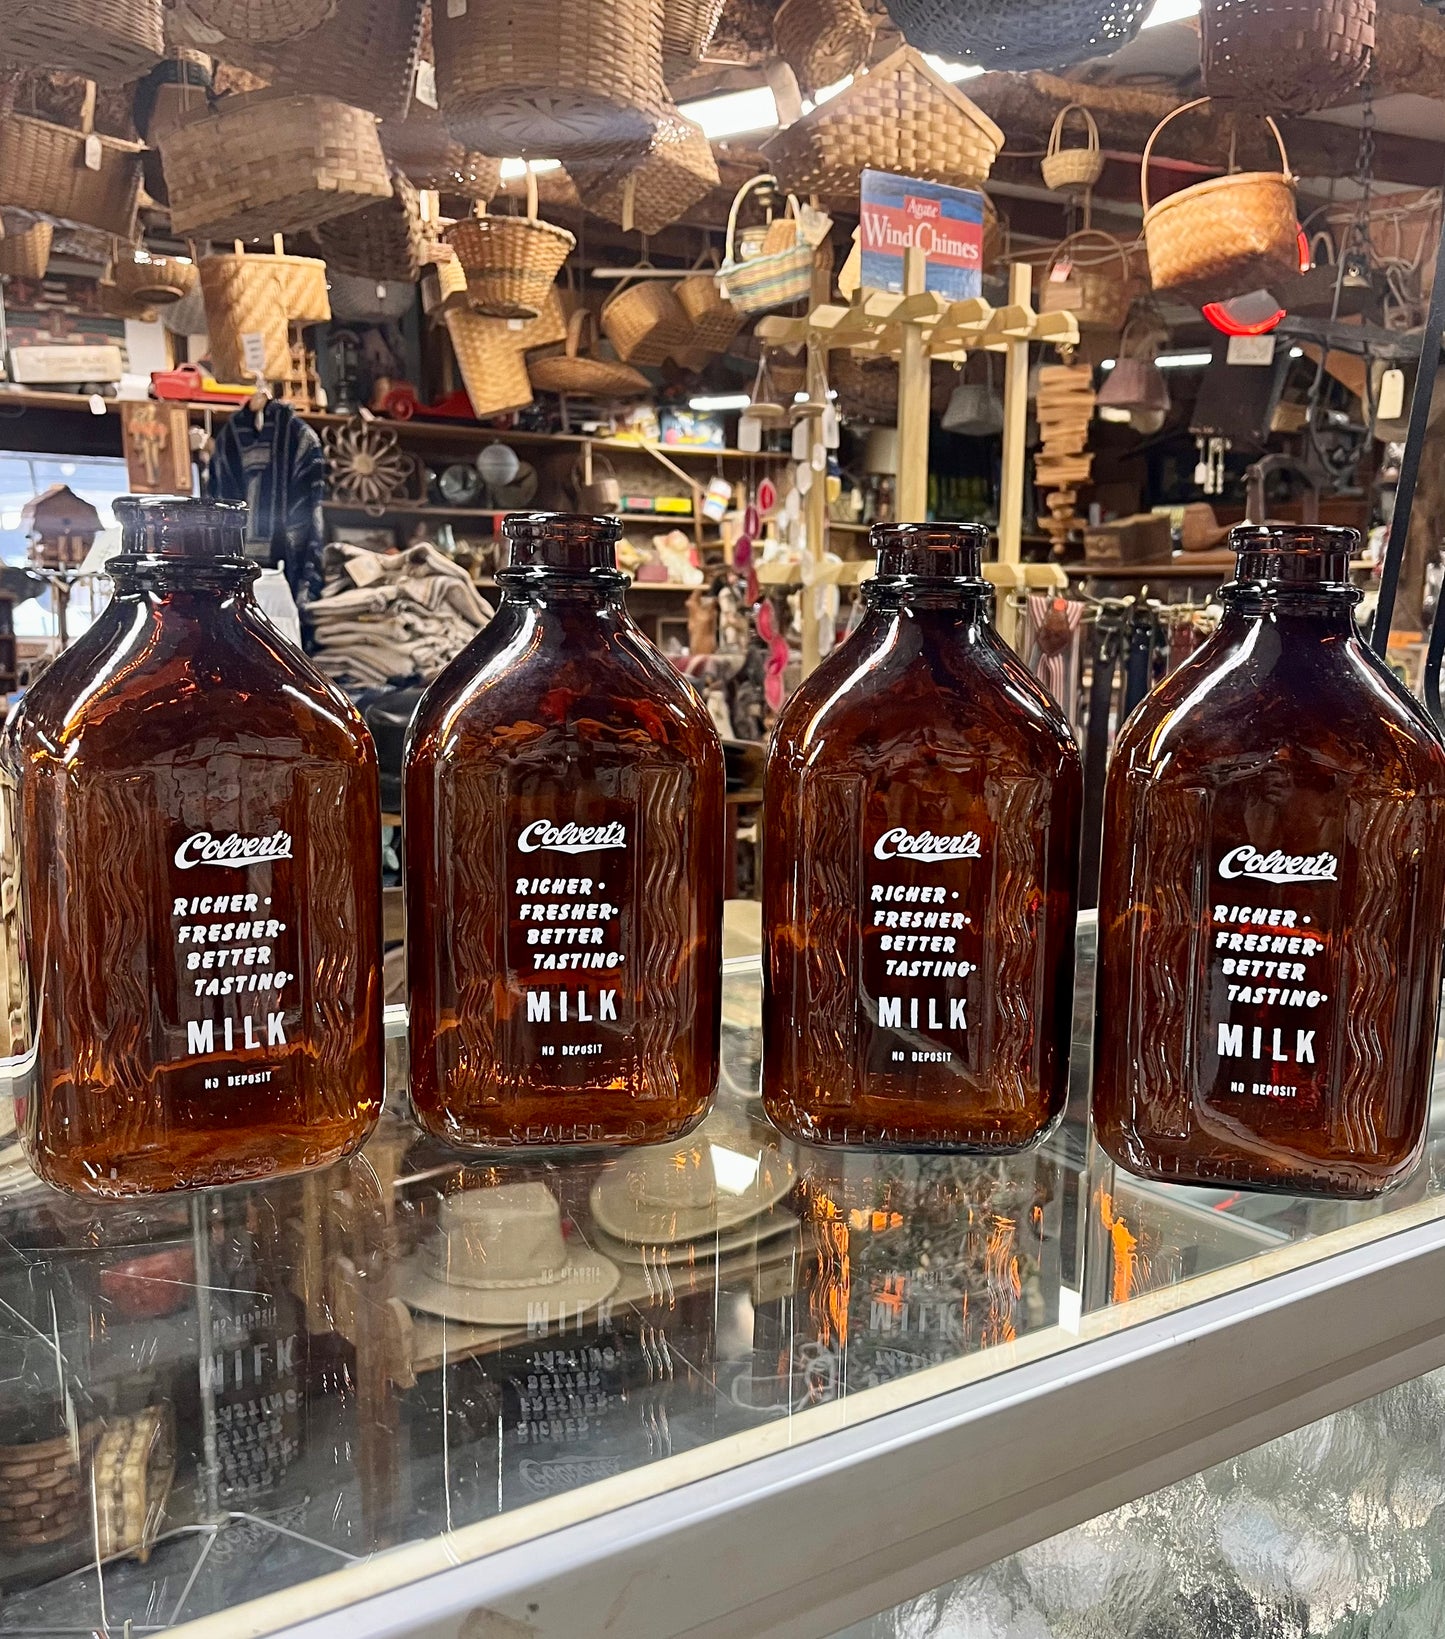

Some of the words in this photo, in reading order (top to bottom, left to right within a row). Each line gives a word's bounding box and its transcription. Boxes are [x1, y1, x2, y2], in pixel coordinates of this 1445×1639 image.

[907, 198, 939, 220] Agate
[863, 211, 913, 248] Wind
[915, 222, 979, 259] Chimes
[175, 831, 293, 869] Colvert's
[518, 820, 626, 854] Colvert's
[874, 828, 981, 862] Colvert's
[1219, 846, 1337, 883] Colvert's
[527, 928, 603, 944] BETTER
[881, 935, 955, 953] BETTER
[187, 946, 271, 970] BETTER
[1222, 959, 1305, 981] BETTER
[527, 990, 616, 1022] MILK
[879, 997, 966, 1029] MILK
[188, 1012, 286, 1054] MILK
[1218, 1023, 1315, 1063] MILK
[542, 1046, 554, 1055] NO
[563, 1044, 602, 1055] DEPOSIT
[892, 1052, 904, 1061] NO
[912, 1052, 951, 1062] DEPOSIT
[205, 1078, 218, 1089] NO
[228, 1072, 271, 1086] DEPOSIT
[1231, 1082, 1244, 1092] NO
[1253, 1084, 1296, 1096] DEPOSIT
